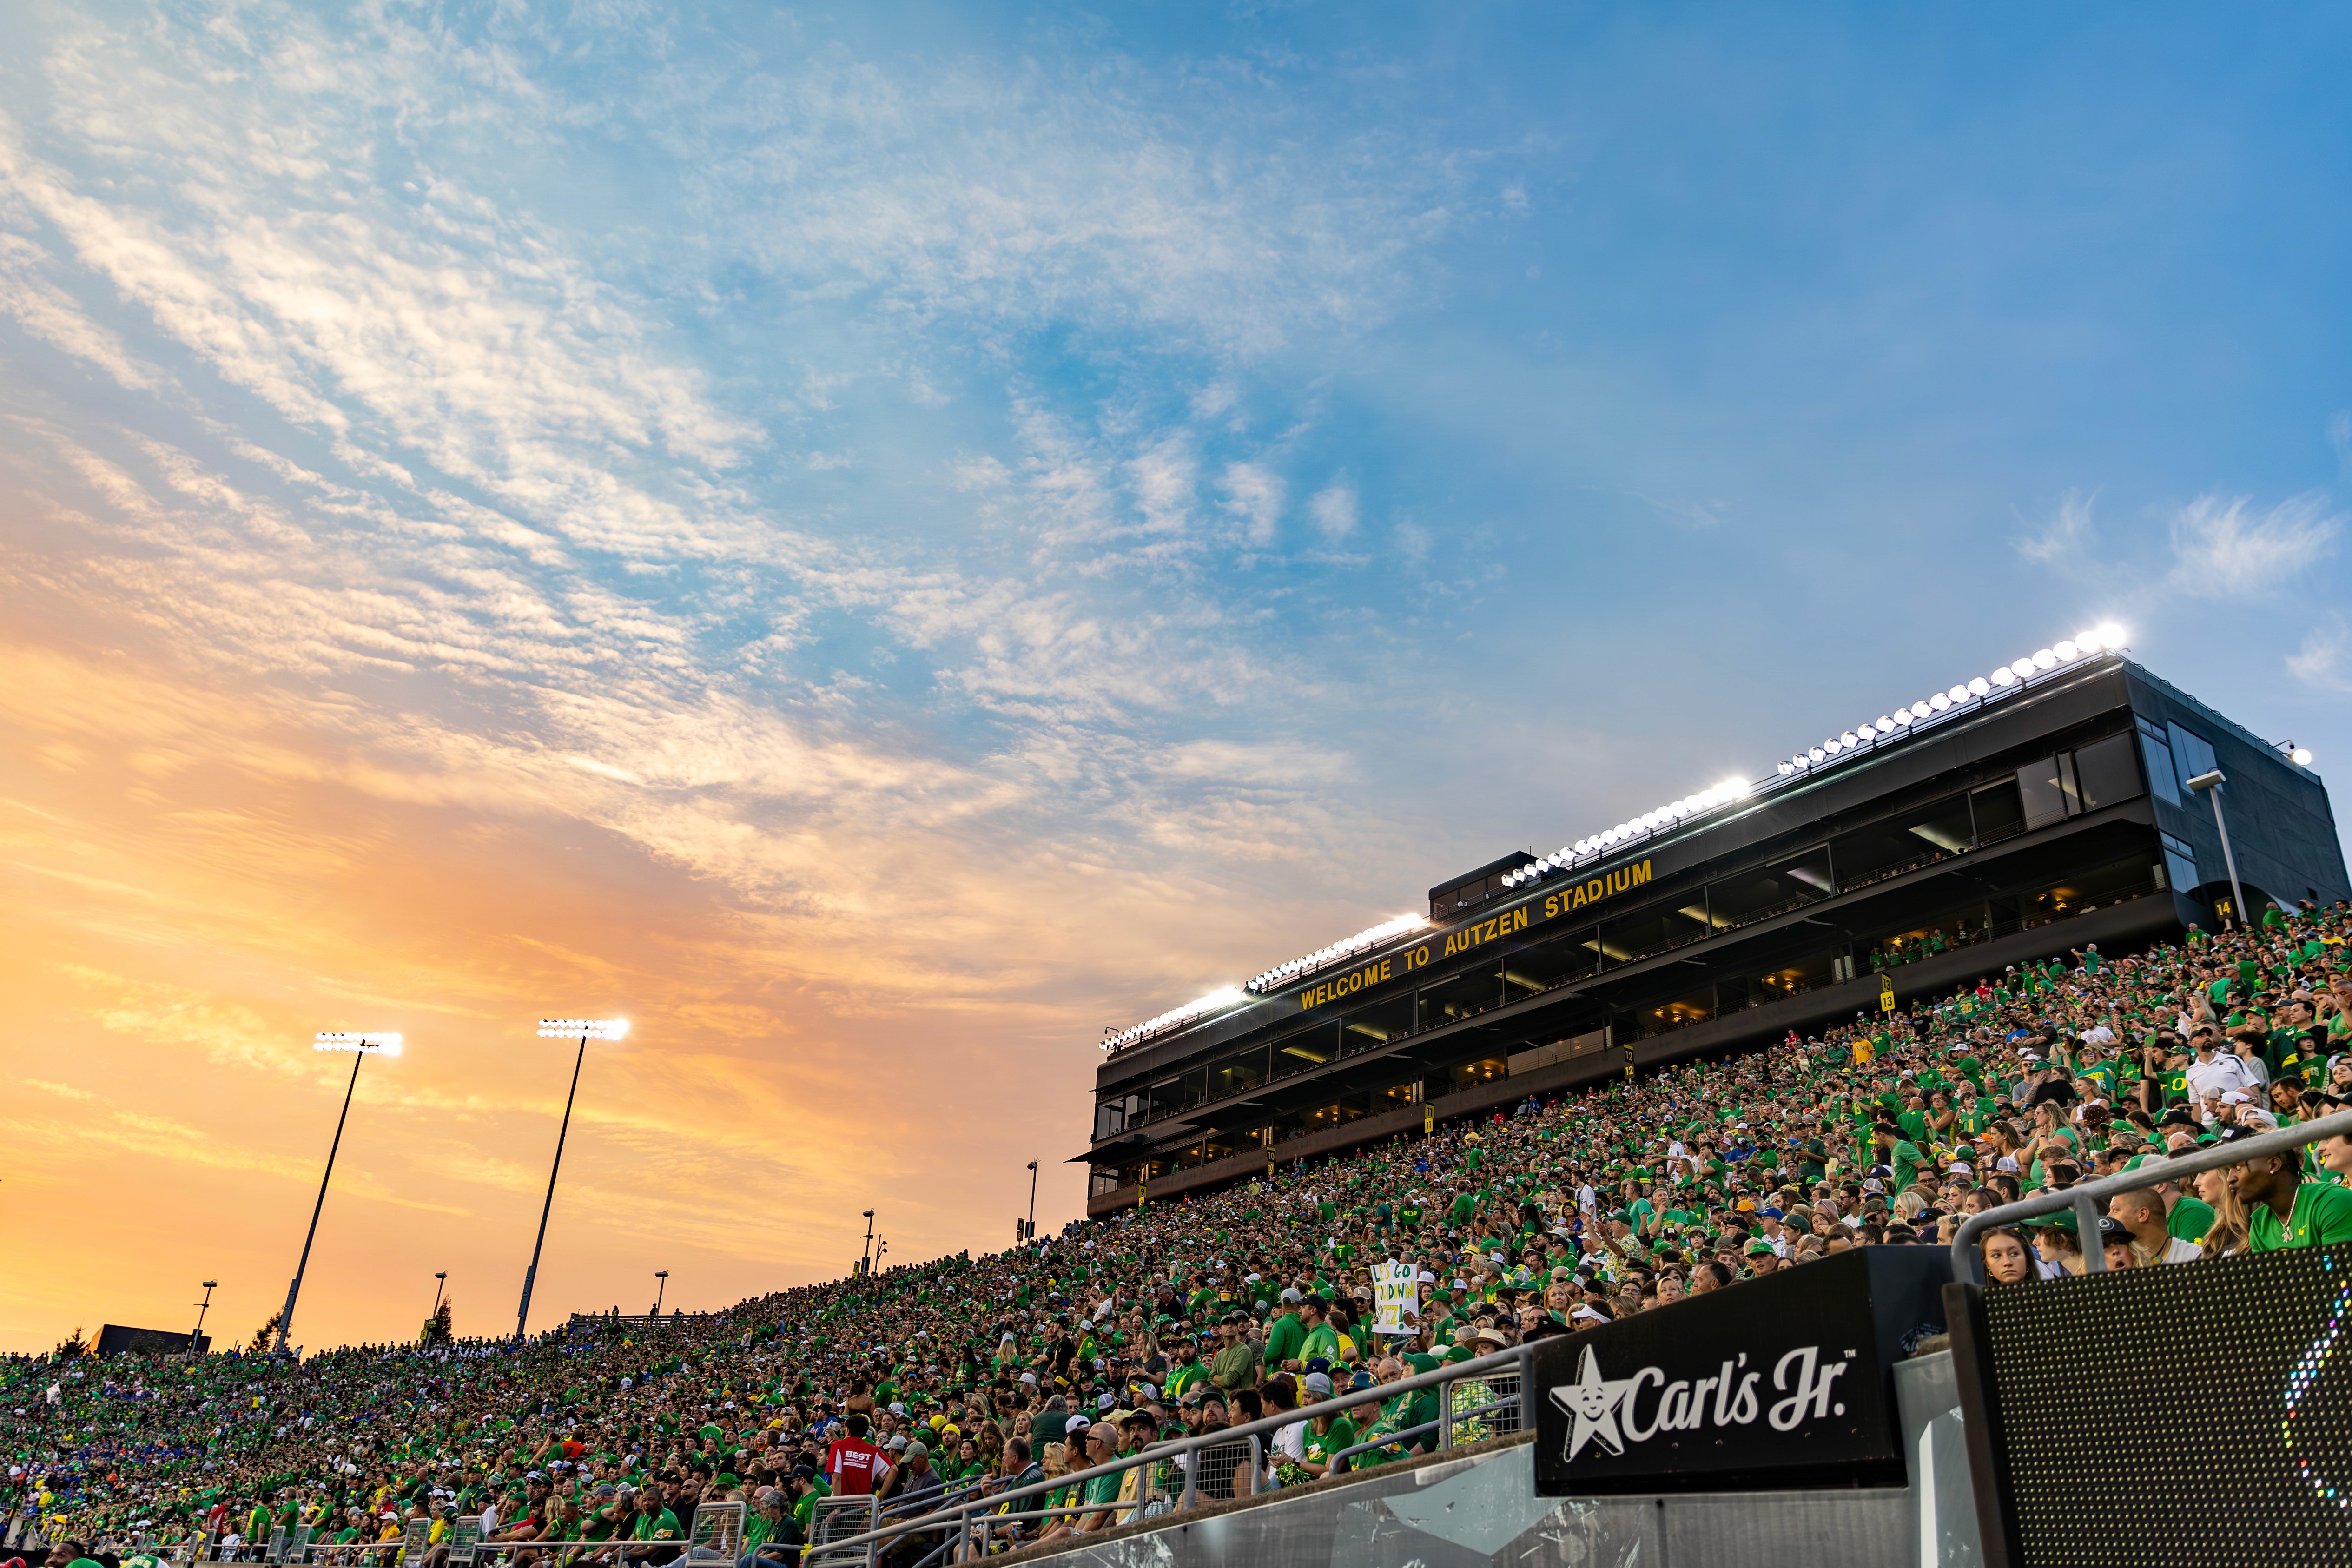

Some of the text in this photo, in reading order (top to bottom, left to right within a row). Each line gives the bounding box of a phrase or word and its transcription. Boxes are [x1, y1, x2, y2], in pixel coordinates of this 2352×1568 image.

[2216, 901, 2231, 916] 14
[1301, 859, 1652, 1010] WELCOME TO AUTZEN STADIUM
[1883, 978, 1890, 991] 13
[1883, 996, 1892, 1007] 13
[1625, 1051, 1633, 1061] 12
[1625, 1065, 1633, 1076] 12
[1427, 1107, 1433, 1117] 11
[1427, 1121, 1431, 1130] 11
[1968, 1118, 1974, 1132] 1
[1268, 1151, 1275, 1160] 10
[1394, 1264, 1411, 1278] GO
[1622, 1352, 1760, 1442] Carl's
[1769, 1346, 1847, 1431] Jr.
[564, 1446, 575, 1458] 7
[845, 1450, 872, 1461] BEST
